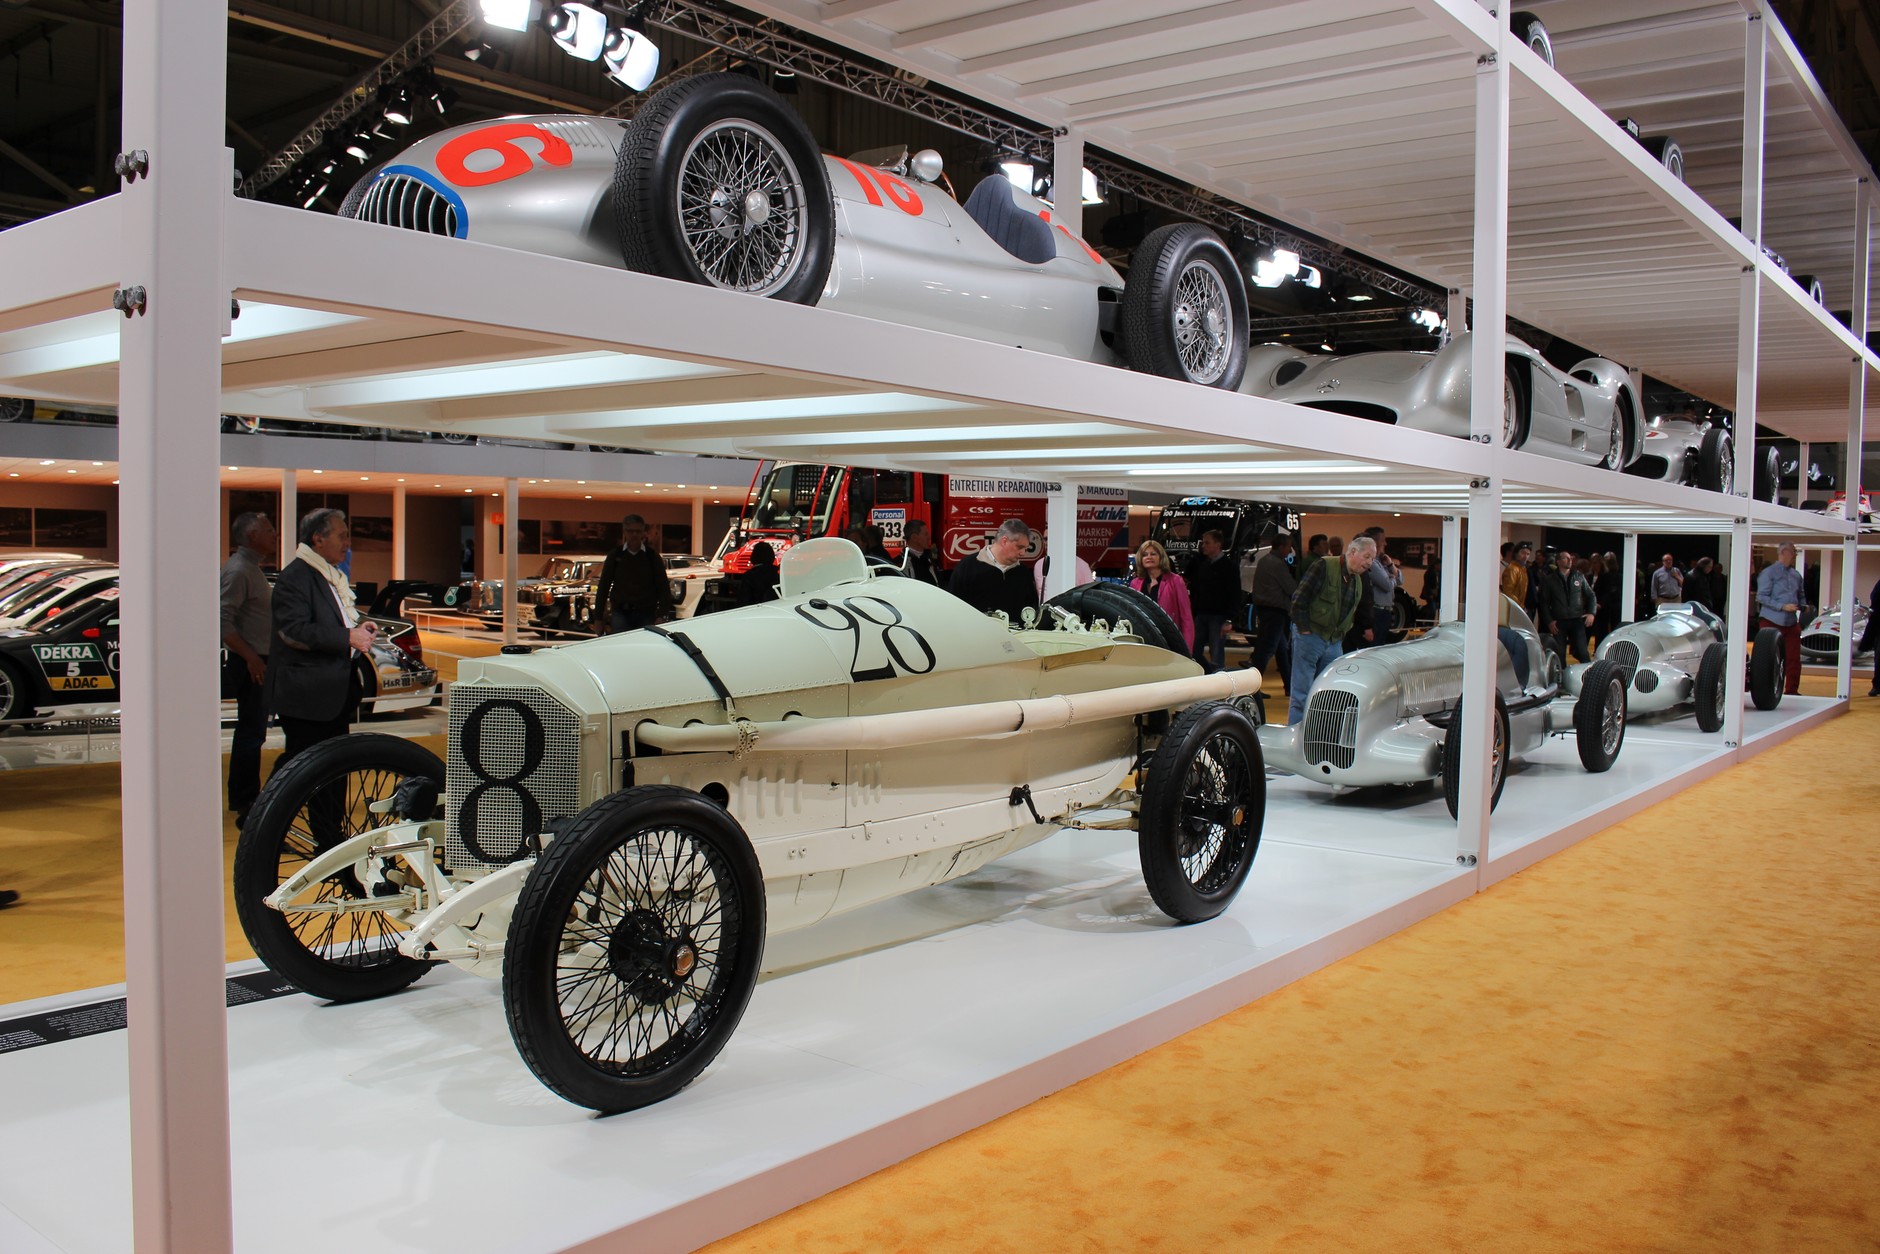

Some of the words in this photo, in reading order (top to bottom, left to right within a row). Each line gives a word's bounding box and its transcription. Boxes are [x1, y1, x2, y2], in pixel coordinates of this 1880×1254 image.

[950, 479, 995, 492] ENTRETIEN
[873, 510, 904, 519] Personal
[969, 506, 994, 514] CSG
[1077, 507, 1127, 520] uckdrive
[1287, 514, 1299, 530] 65
[877, 522, 902, 538] 533
[1078, 528, 1114, 536] MARKEN-
[1076, 538, 1109, 547] ERKSTATT
[40, 646, 94, 660] DEKRA
[67, 662, 81, 677] 5
[62, 677, 99, 689] ADAC
[383, 679, 401, 688] H&R
[61, 717, 121, 726] PETRONAS
[459, 699, 545, 863] 8
